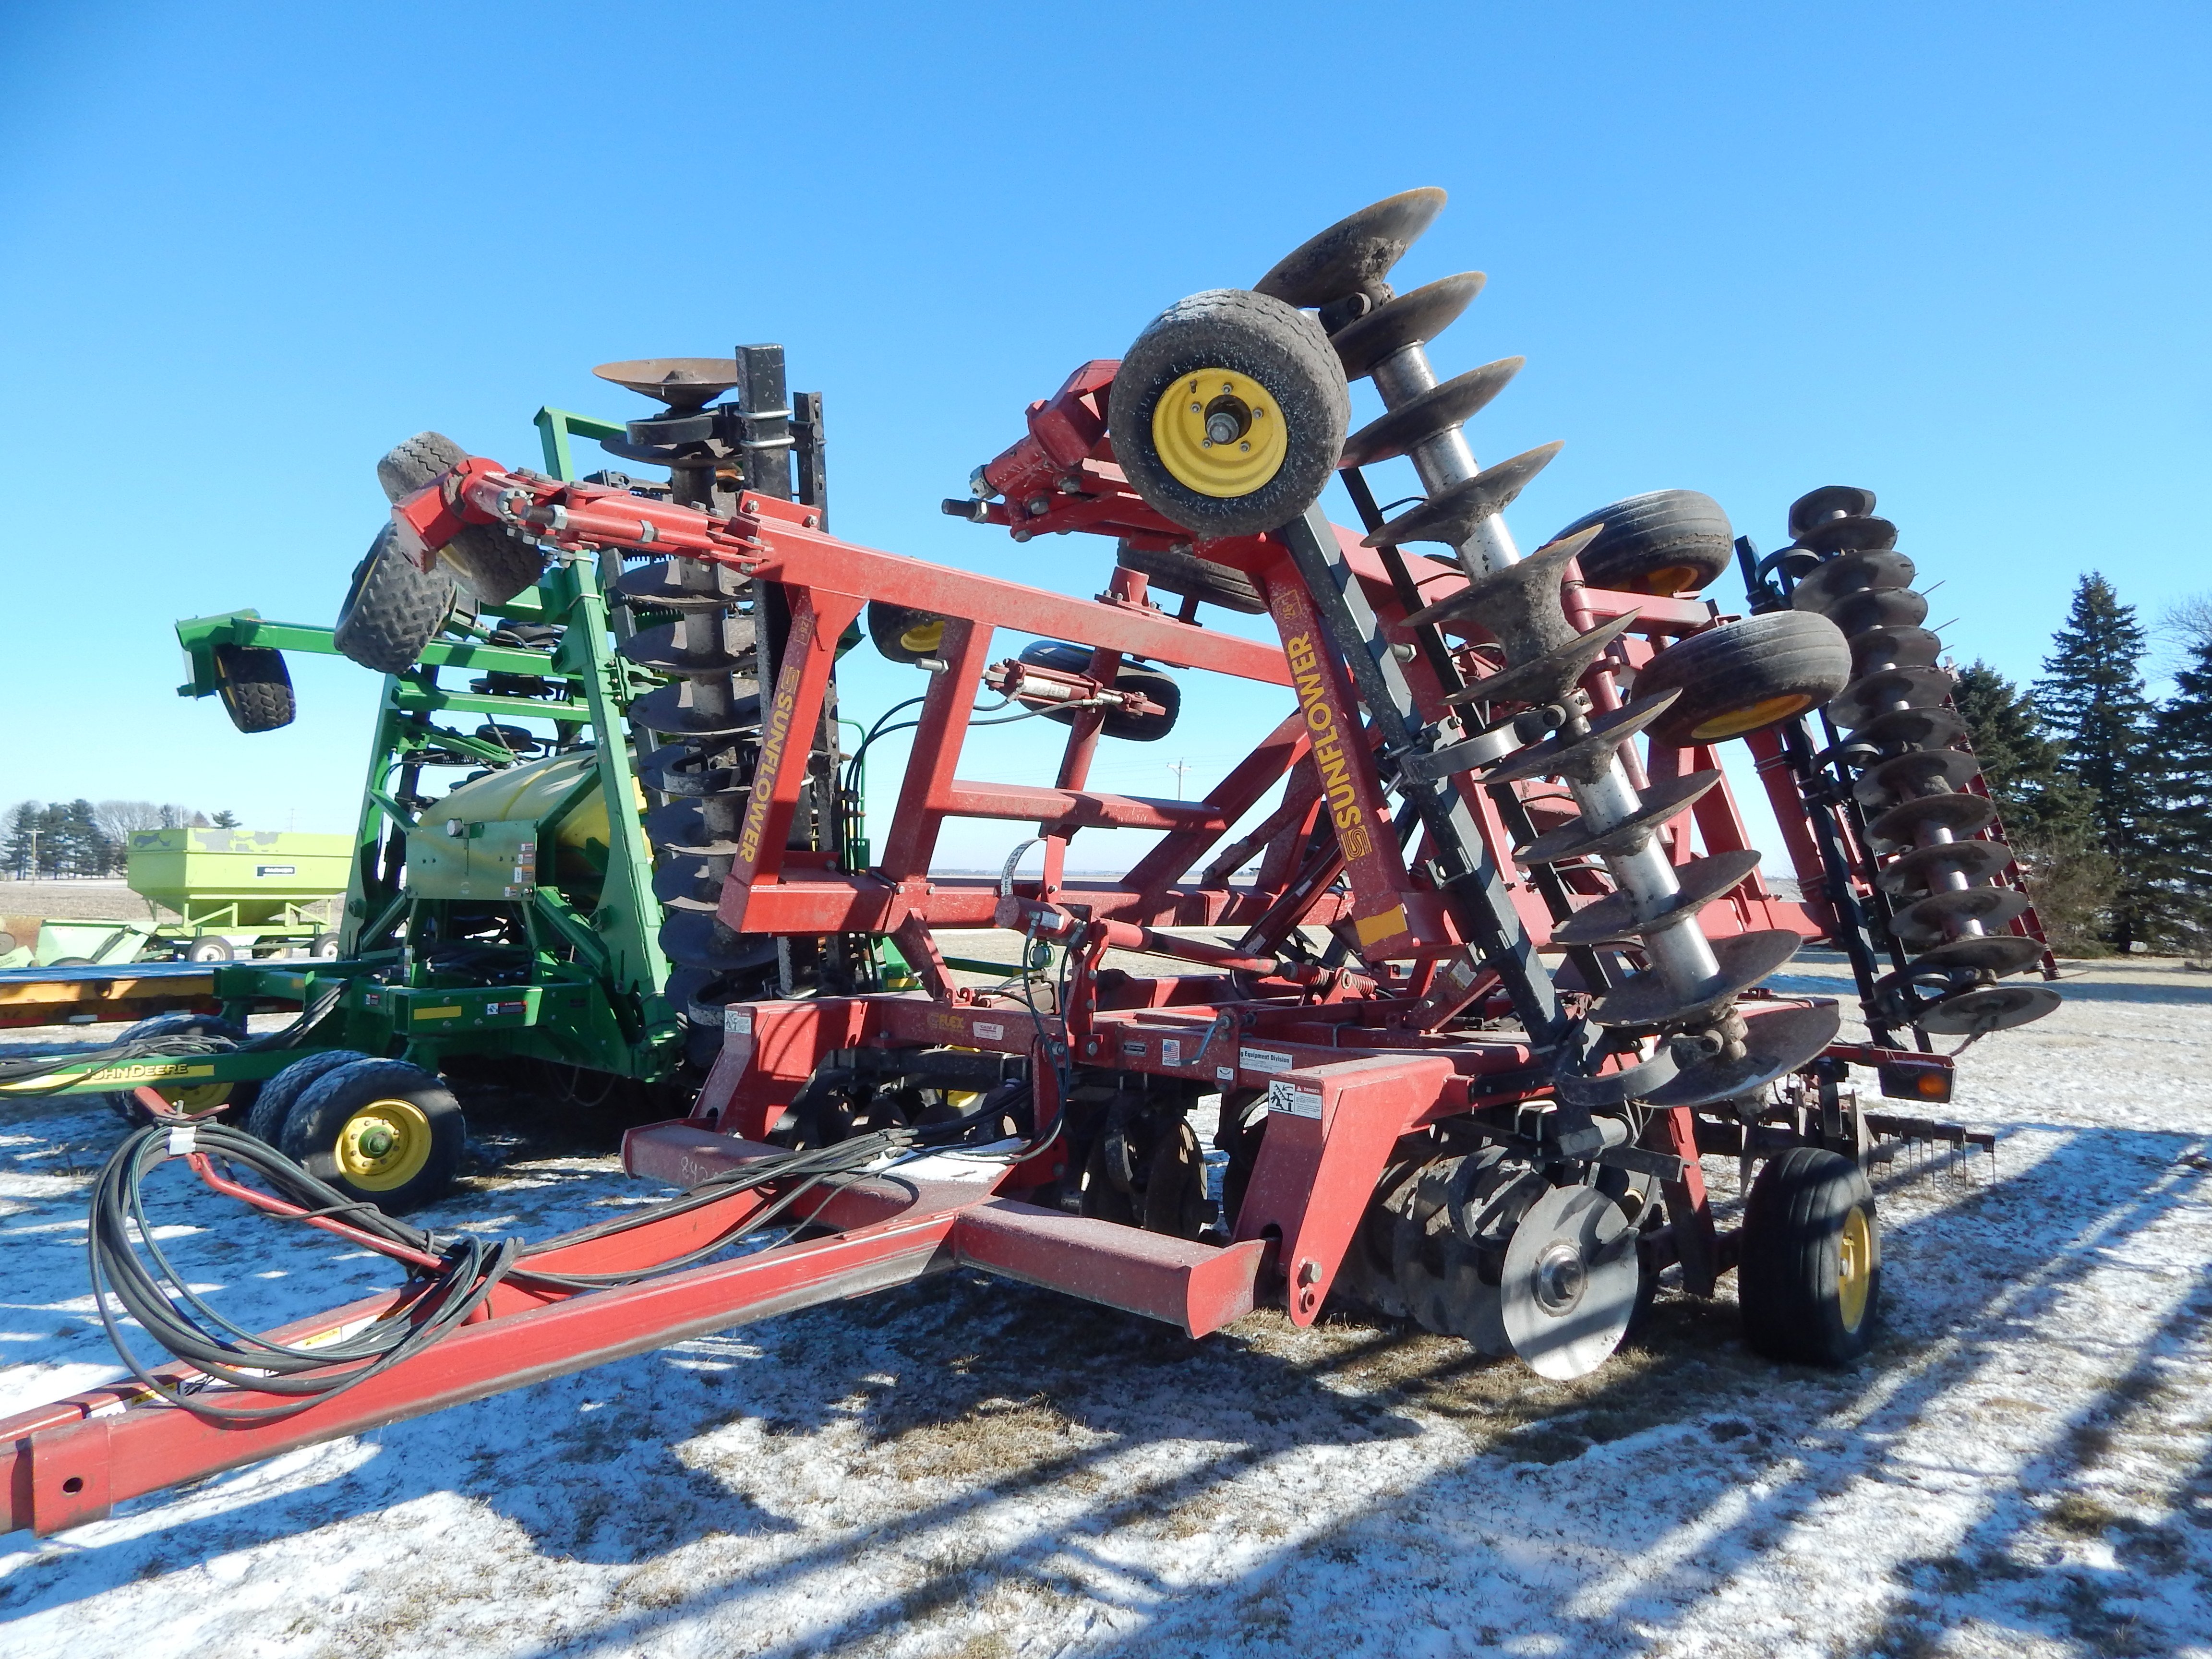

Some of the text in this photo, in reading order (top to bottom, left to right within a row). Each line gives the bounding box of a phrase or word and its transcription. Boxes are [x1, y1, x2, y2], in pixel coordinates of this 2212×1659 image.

[1287, 631, 1362, 830] SUNFLOWER
[739, 692, 793, 863] SUNFLOWER
[130, 1064, 188, 1078] DEERE
[1245, 1051, 1269, 1060] Equipment
[1270, 1055, 1290, 1063] Division
